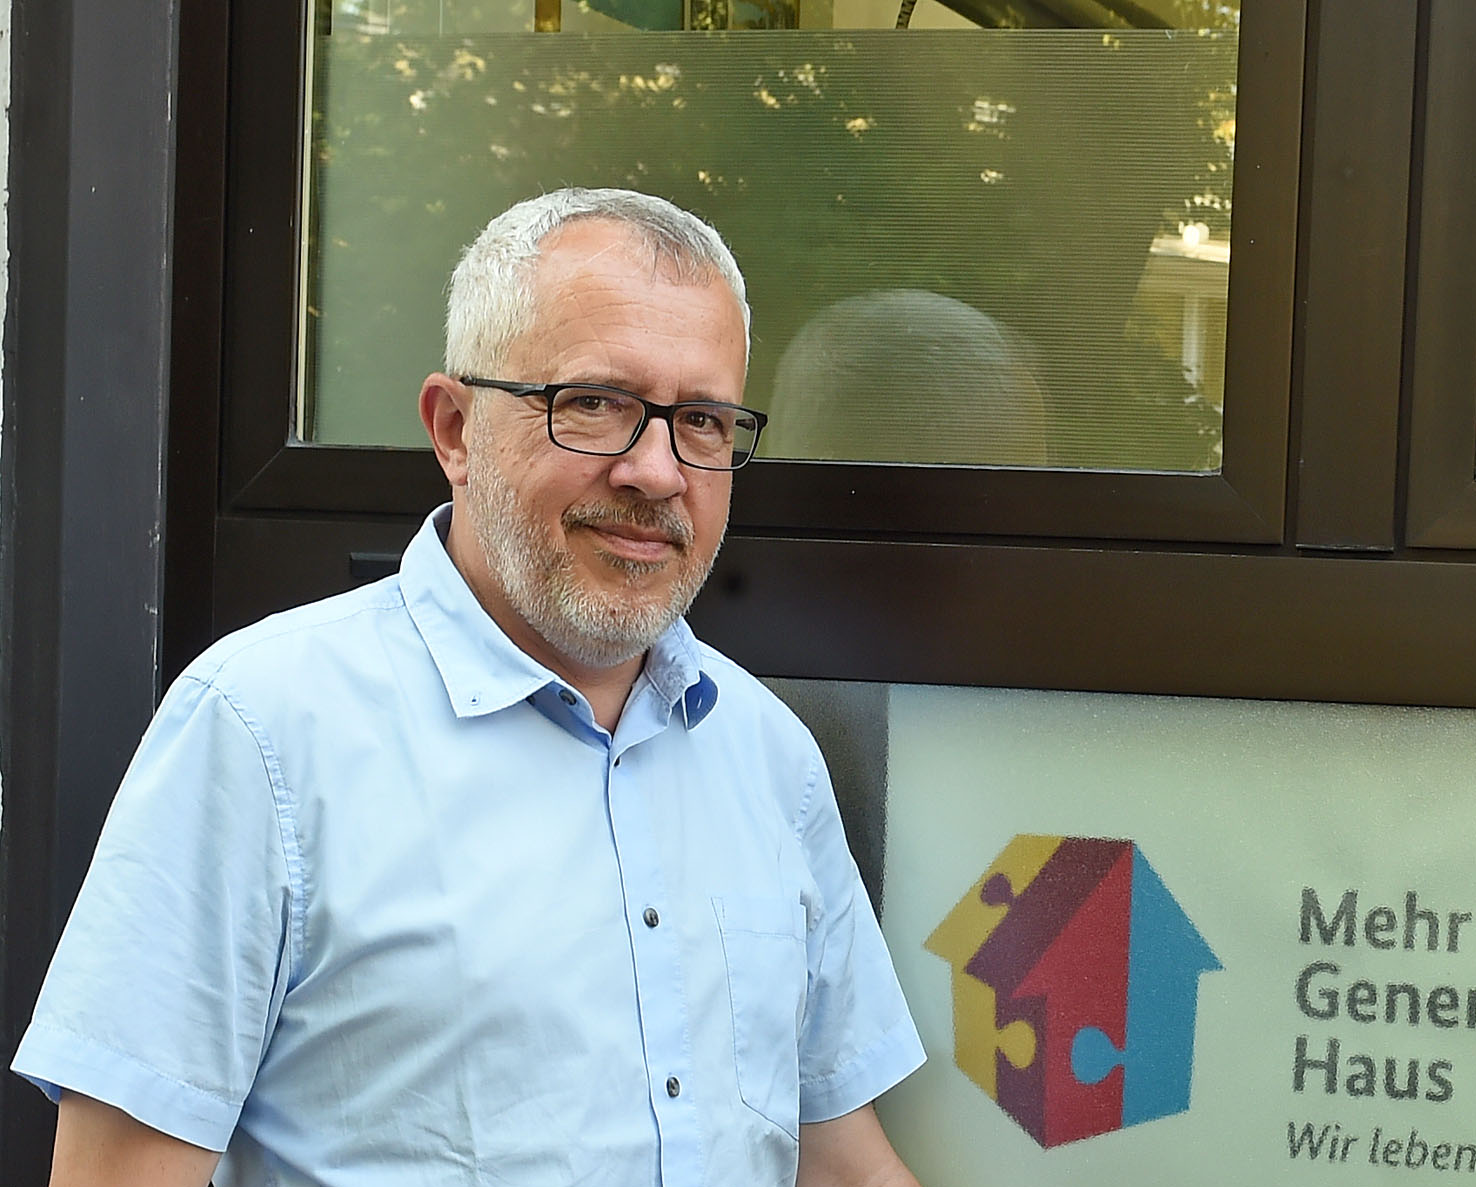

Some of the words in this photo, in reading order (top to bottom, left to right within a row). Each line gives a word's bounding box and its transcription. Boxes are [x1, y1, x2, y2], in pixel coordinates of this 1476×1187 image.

[1299, 885, 1472, 953] Mehr
[1292, 1034, 1454, 1102] Haus
[1287, 1120, 1359, 1163] Wir
